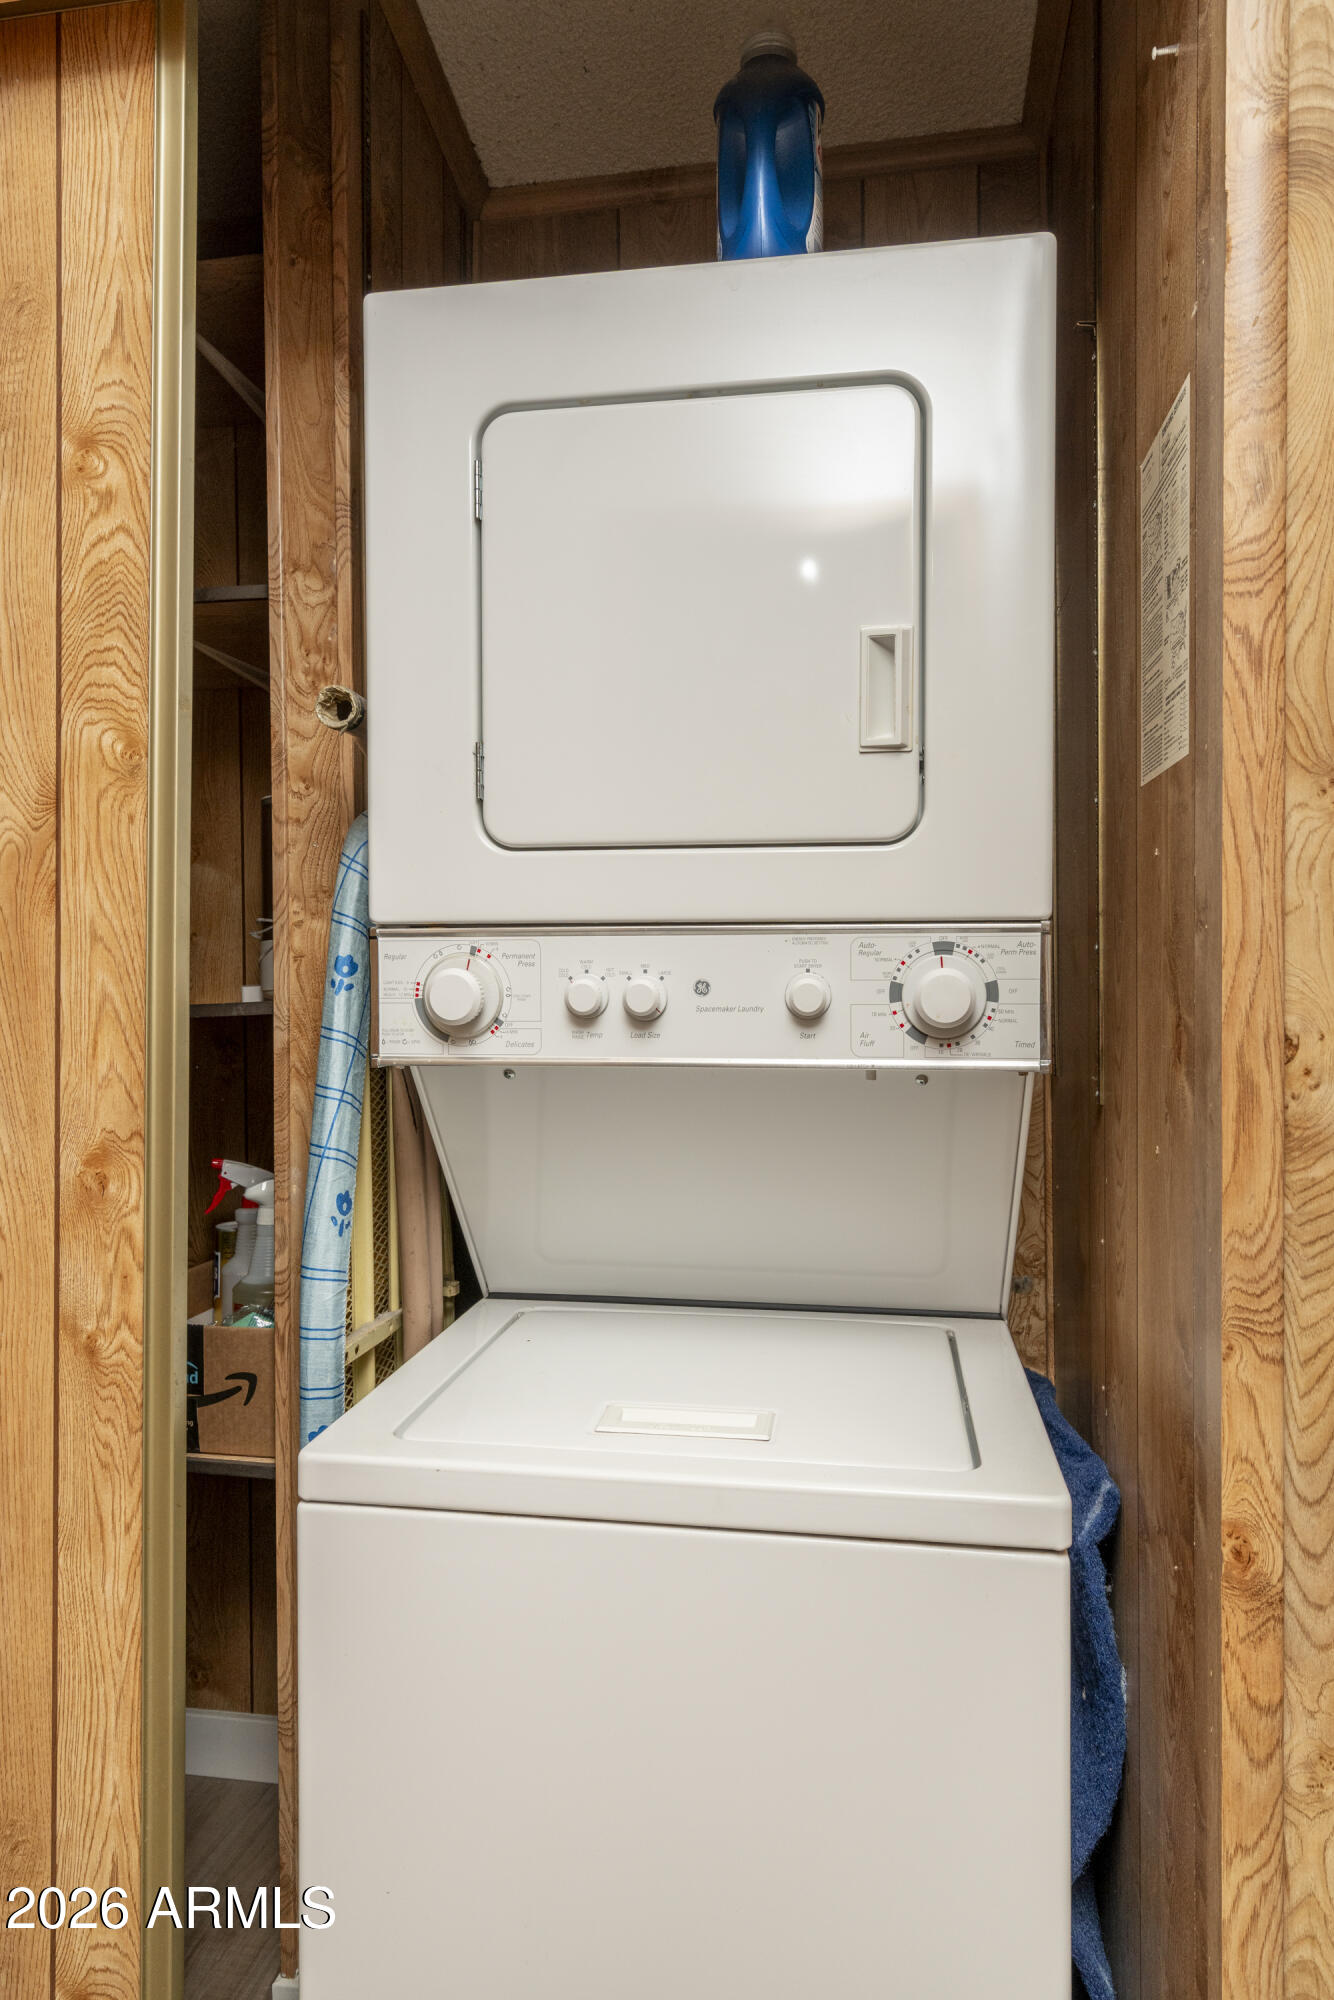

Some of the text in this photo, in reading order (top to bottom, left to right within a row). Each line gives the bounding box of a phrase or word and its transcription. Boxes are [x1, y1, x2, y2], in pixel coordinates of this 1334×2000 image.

[858, 941, 877, 949] Auto-
[1017, 940, 1036, 948] Auto-
[858, 949, 882, 957] Regular
[1000, 948, 1017, 956] Perm
[1018, 948, 1036, 956] Press
[384, 953, 408, 961] Regular
[695, 1004, 765, 1014] Spacemaker Laundry
[586, 1031, 604, 1040] Temp
[630, 1031, 661, 1039] Load Size
[799, 1032, 816, 1040] Start
[859, 1031, 870, 1039] Air
[505, 1040, 535, 1048] Delicates
[859, 1039, 875, 1047] Fluff
[1015, 1040, 1036, 1049] Timed
